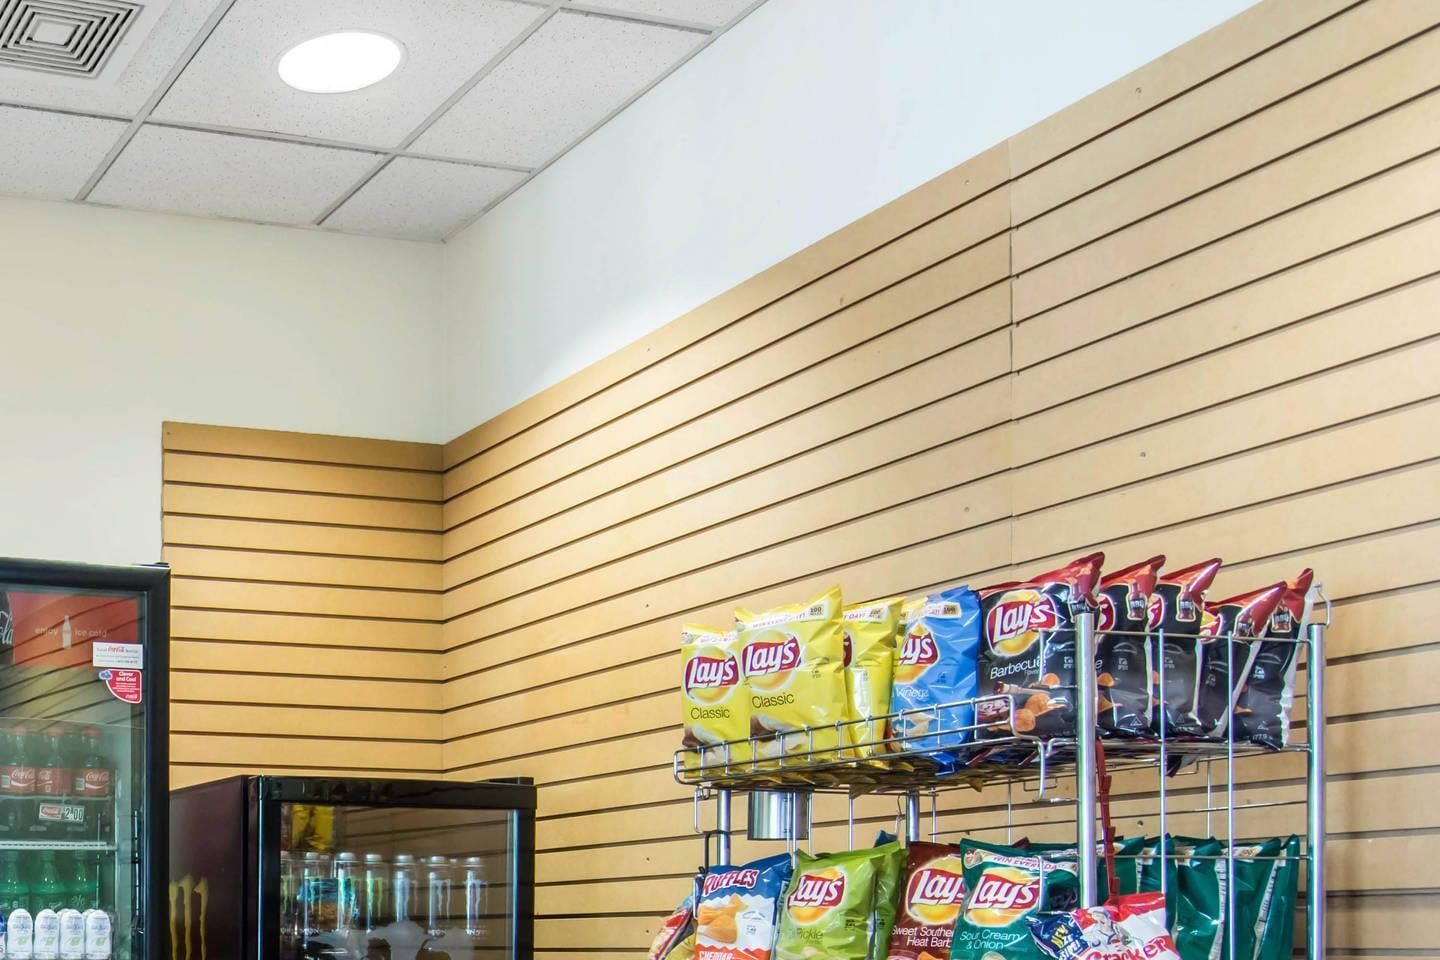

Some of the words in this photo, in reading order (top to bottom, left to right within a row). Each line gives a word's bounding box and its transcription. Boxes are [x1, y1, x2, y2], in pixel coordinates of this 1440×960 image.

[992, 600, 1051, 645] Lay's
[744, 637, 799, 673] Lay's
[900, 634, 932, 665] ay's
[688, 655, 739, 688] Lay's
[751, 692, 795, 709] Classic
[690, 707, 730, 720] Classic
[703, 869, 759, 896] RUFFLES
[968, 875, 1039, 910] Lay's
[906, 936, 926, 947] Heat
[919, 926, 954, 938] Souther
[960, 930, 979, 941] Sour
[980, 930, 1020, 942] Cream
[973, 938, 1003, 950] Onion
